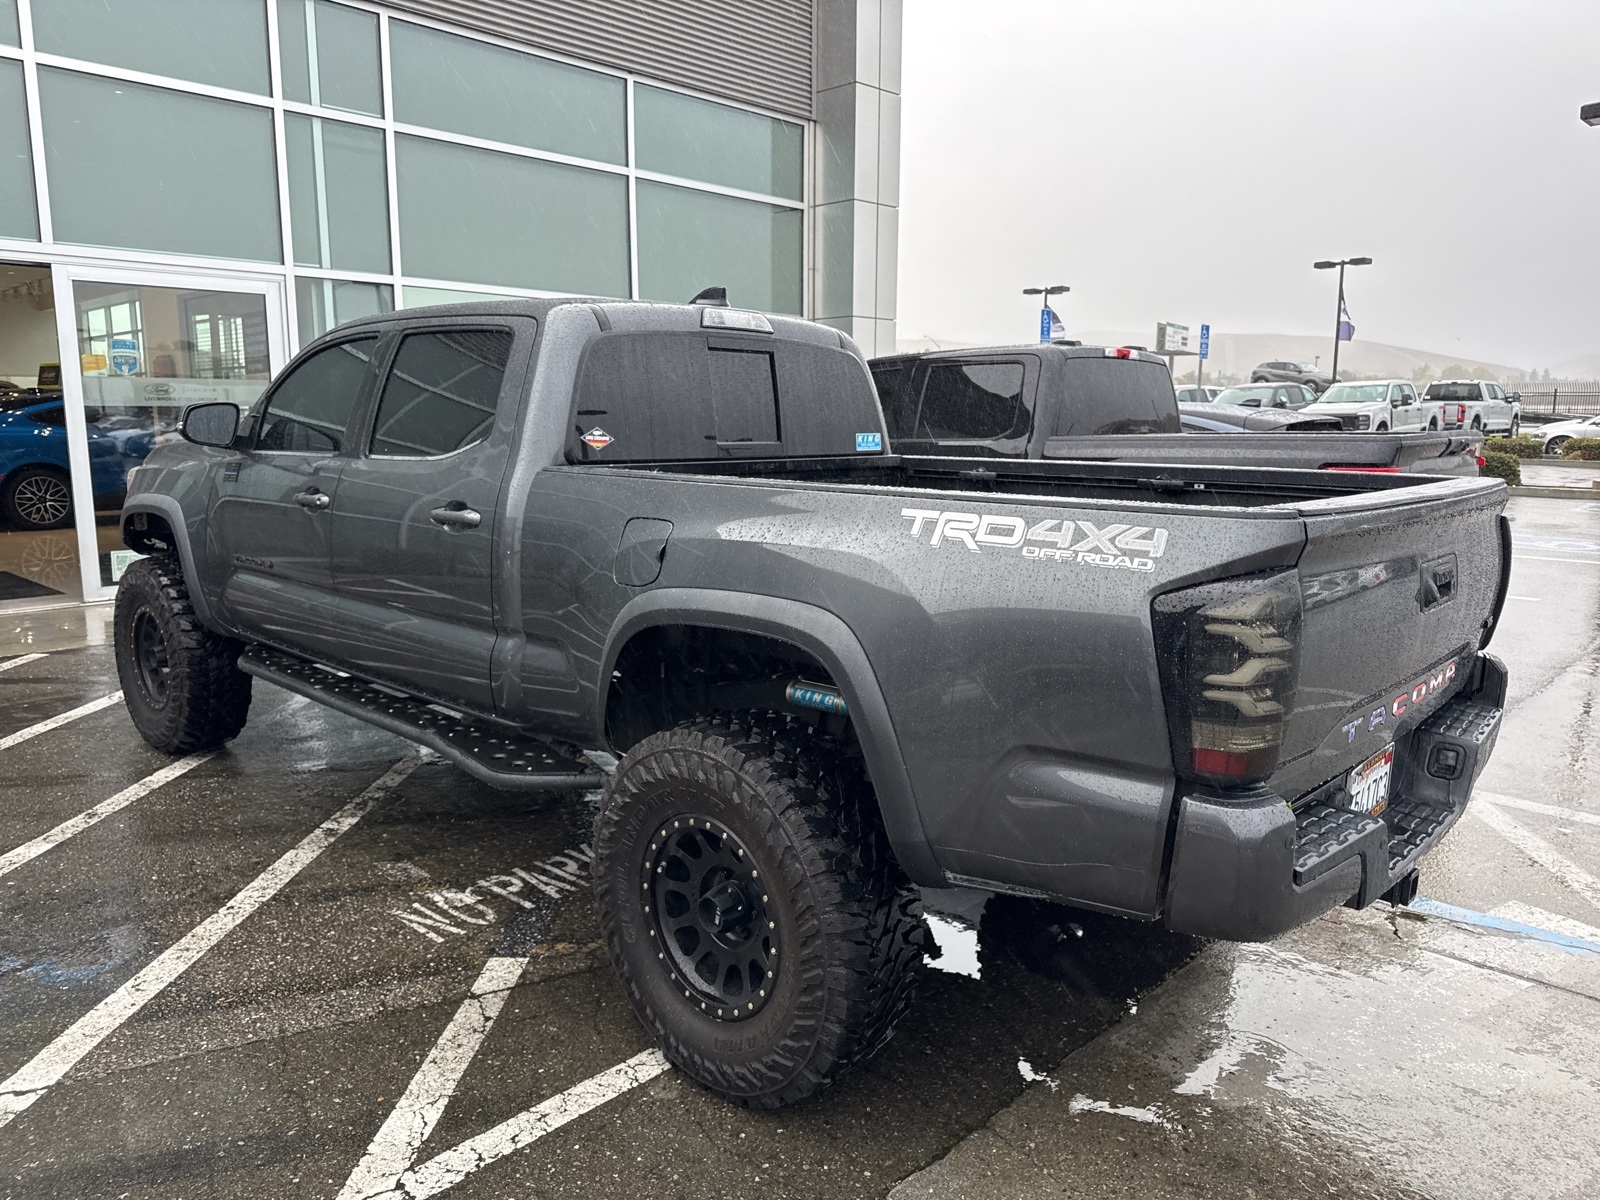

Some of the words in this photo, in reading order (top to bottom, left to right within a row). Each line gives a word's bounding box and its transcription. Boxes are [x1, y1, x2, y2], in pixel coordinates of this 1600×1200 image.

[858, 434, 880, 443] KING
[901, 508, 1027, 553] TRD
[1026, 519, 1169, 557] 4X4
[1021, 545, 1076, 562] OFF
[1076, 551, 1156, 573] ROAD
[794, 688, 835, 706] KING
[1341, 661, 1456, 743] TACOMA
